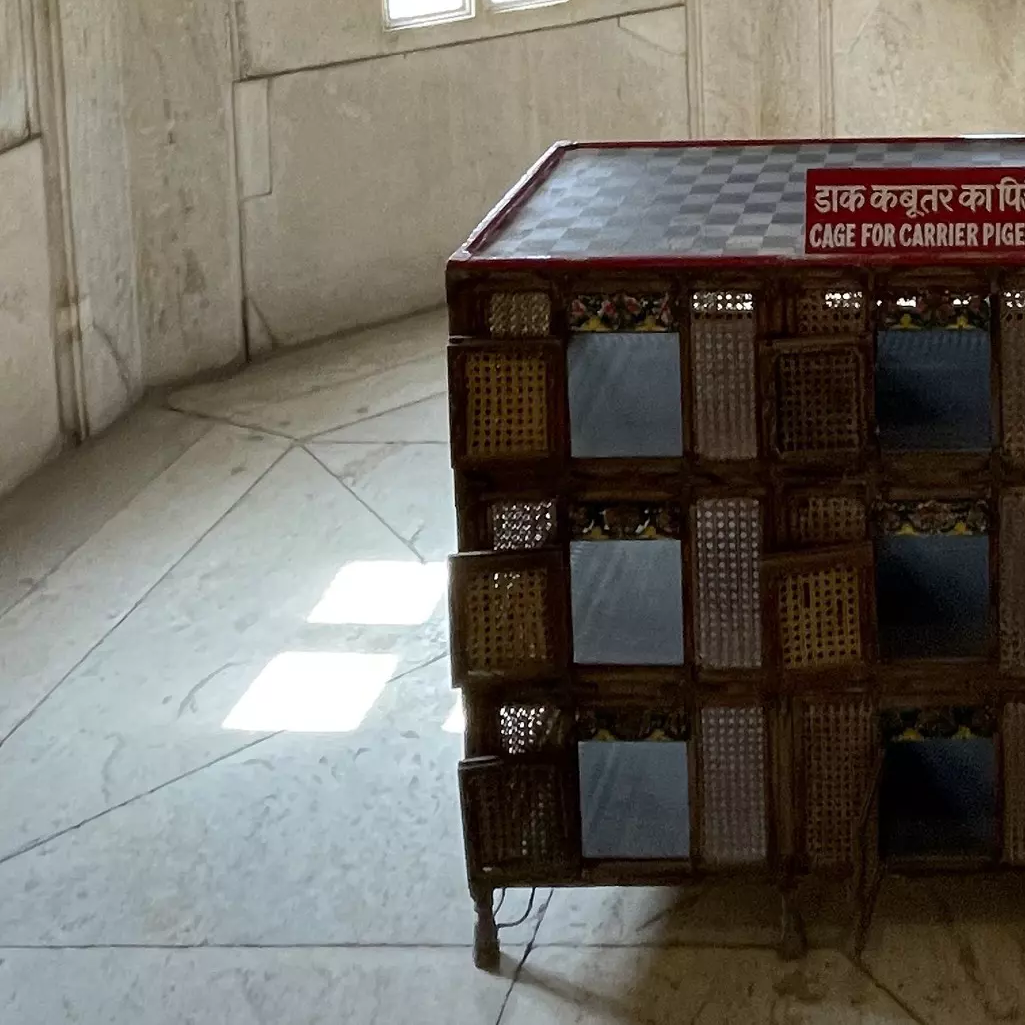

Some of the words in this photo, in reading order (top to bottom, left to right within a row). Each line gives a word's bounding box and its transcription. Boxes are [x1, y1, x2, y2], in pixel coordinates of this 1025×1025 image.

[814, 184, 868, 213] डाक
[870, 184, 957, 219] कबूतर
[958, 184, 995, 213] का
[809, 222, 856, 248] CAGE
[861, 223, 896, 247] FOR
[899, 223, 979, 247] CARRIER
